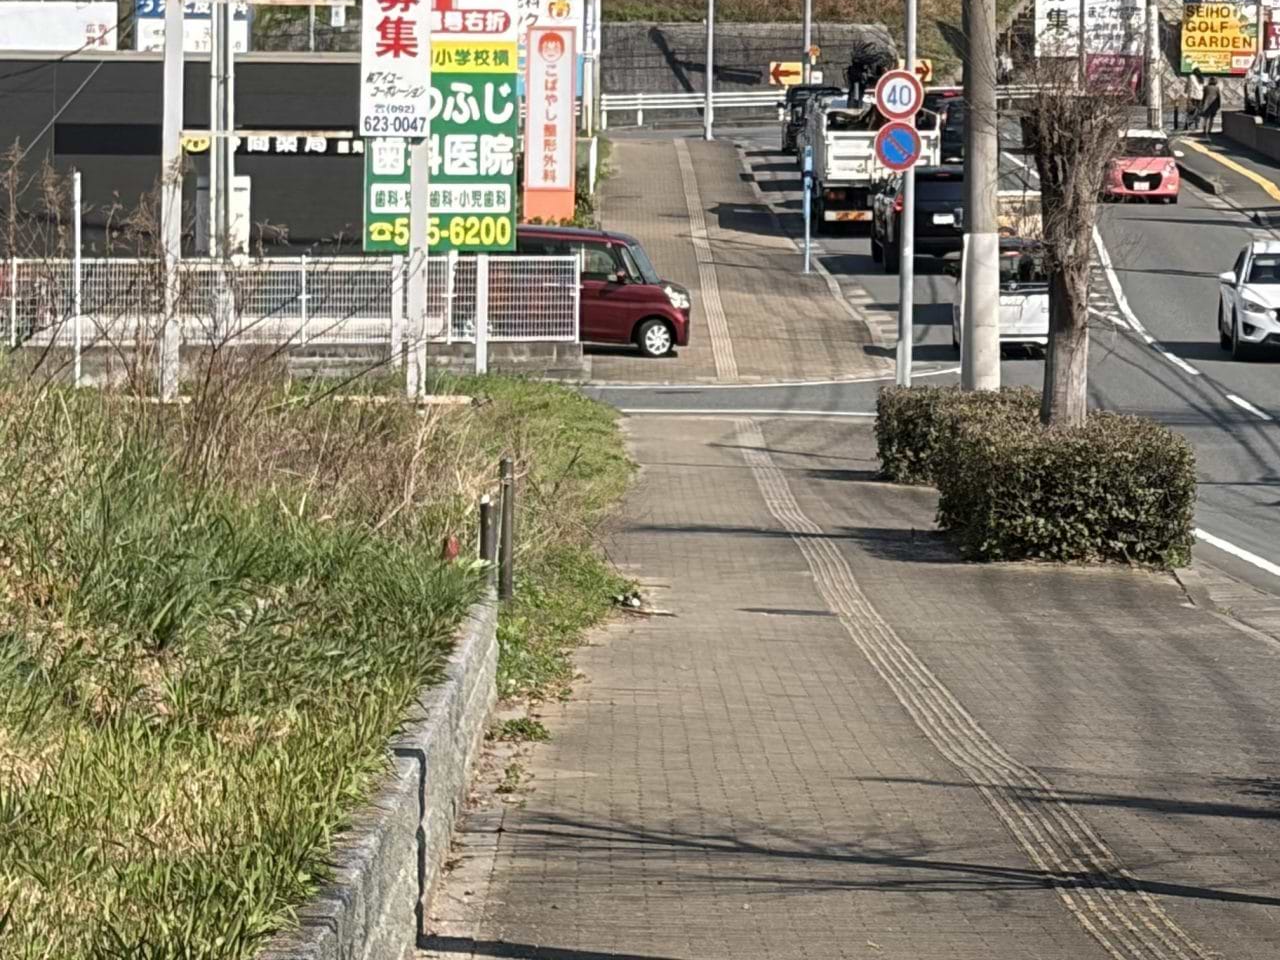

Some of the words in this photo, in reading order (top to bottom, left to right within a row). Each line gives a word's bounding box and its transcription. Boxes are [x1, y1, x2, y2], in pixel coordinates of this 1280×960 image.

[1185, 6, 1231, 19] SEIHO
[1185, 21, 1229, 34] GOLF
[1185, 36, 1253, 49] GARDEN
[431, 48, 510, 66] 小学校横
[886, 84, 913, 106] 40
[364, 115, 426, 133] 623-0047
[394, 216, 512, 246] 55-6200
